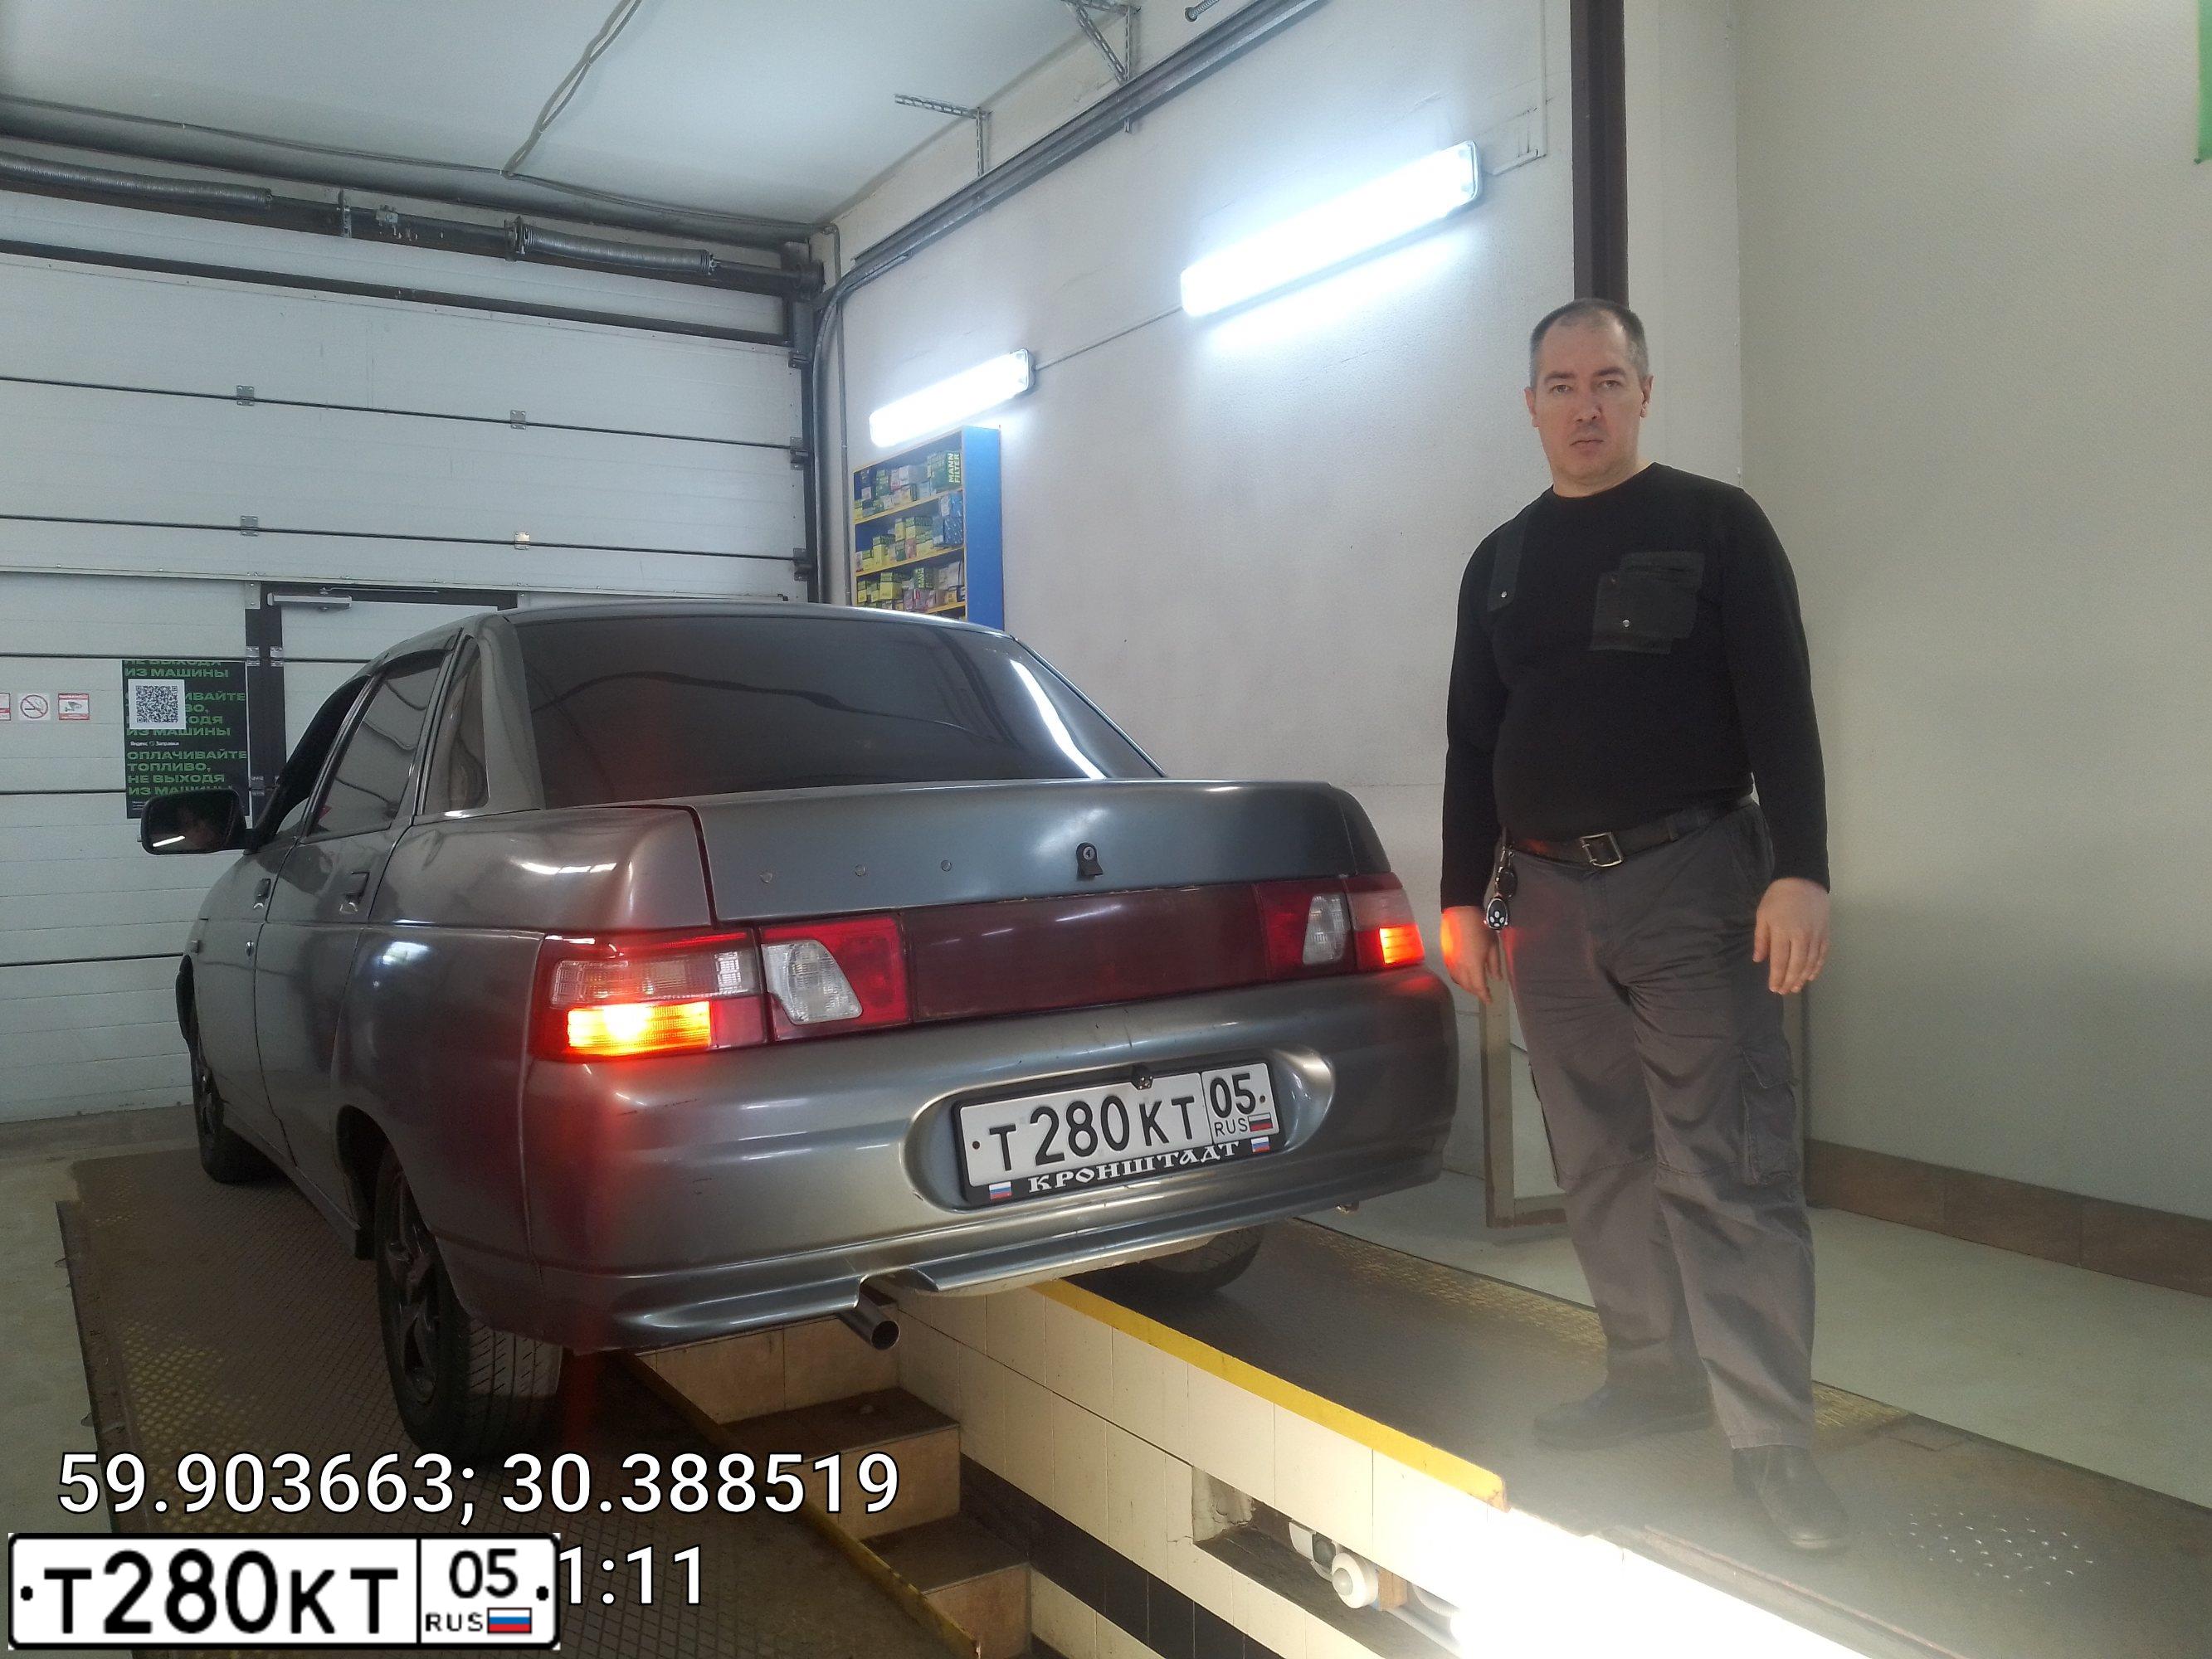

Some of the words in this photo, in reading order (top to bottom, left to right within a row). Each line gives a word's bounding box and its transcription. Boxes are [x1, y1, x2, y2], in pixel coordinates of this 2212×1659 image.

[124, 668, 147, 677] ИЗ
[150, 669, 229, 678] МАШИНЫ
[153, 727, 231, 737] МАШИНЫ
[127, 749, 247, 760] ОПЛАЧИВАЙТЕ
[127, 763, 211, 773] ТОПЛИВО,
[128, 775, 149, 783] НЕ
[153, 774, 225, 784] ВЫХОДЯ
[129, 786, 151, 795] ИЗ
[1209, 1073, 1257, 1119] 05
[1214, 1117, 1248, 1138] RUS
[1028, 1140, 1240, 1193] КРОНШТАДТ
